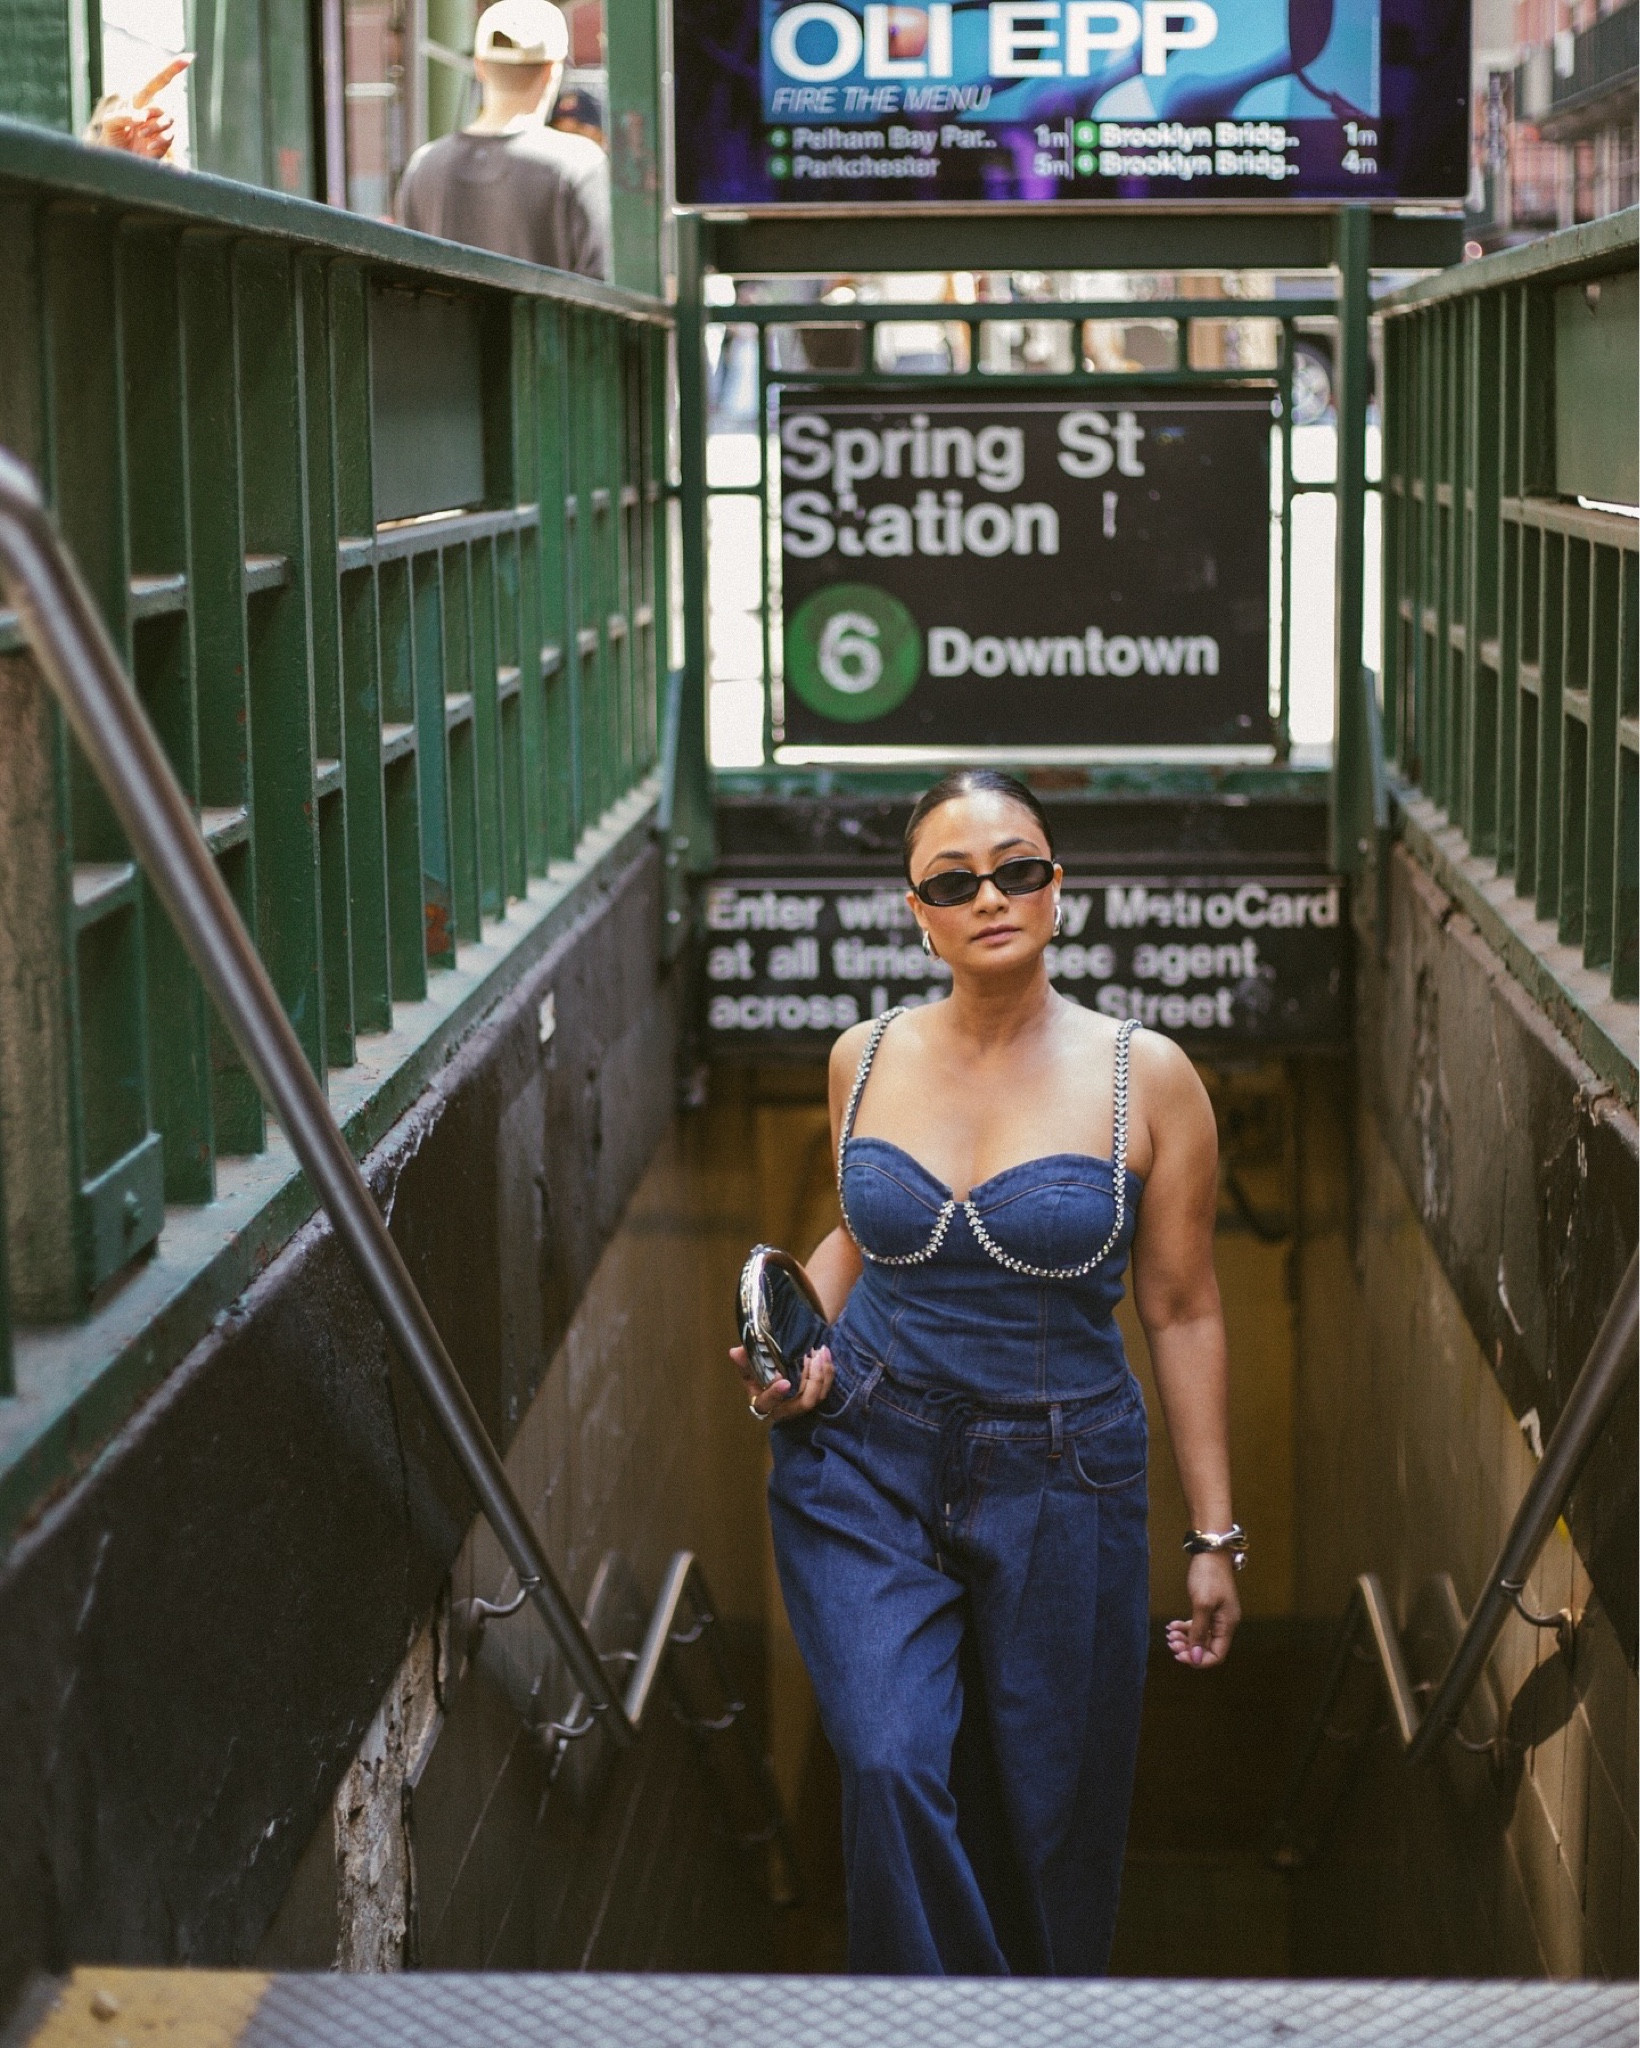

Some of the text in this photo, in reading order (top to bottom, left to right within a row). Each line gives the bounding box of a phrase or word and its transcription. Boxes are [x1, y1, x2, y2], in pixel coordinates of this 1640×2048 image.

[770, 1, 1219, 83] OLI EPP
[771, 85, 992, 114] FIRE THE MENU
[792, 126, 885, 150] Pelham
[888, 125, 938, 154] Bay
[1100, 122, 1212, 152] Brooklyn
[792, 154, 940, 178] Parkchester
[1100, 150, 1212, 180] Brooklyn
[781, 409, 1146, 493] Spring St
[781, 489, 1061, 558] Station
[817, 610, 1221, 694] 6 Downtown
[706, 886, 824, 931] Enter
[1060, 893, 1093, 937] y
[1104, 882, 1340, 929] MetroCard
[707, 938, 755, 981] at
[768, 936, 820, 981] all
[1132, 936, 1260, 987] agent
[707, 994, 860, 1030] across
[1094, 984, 1235, 1029] Street
